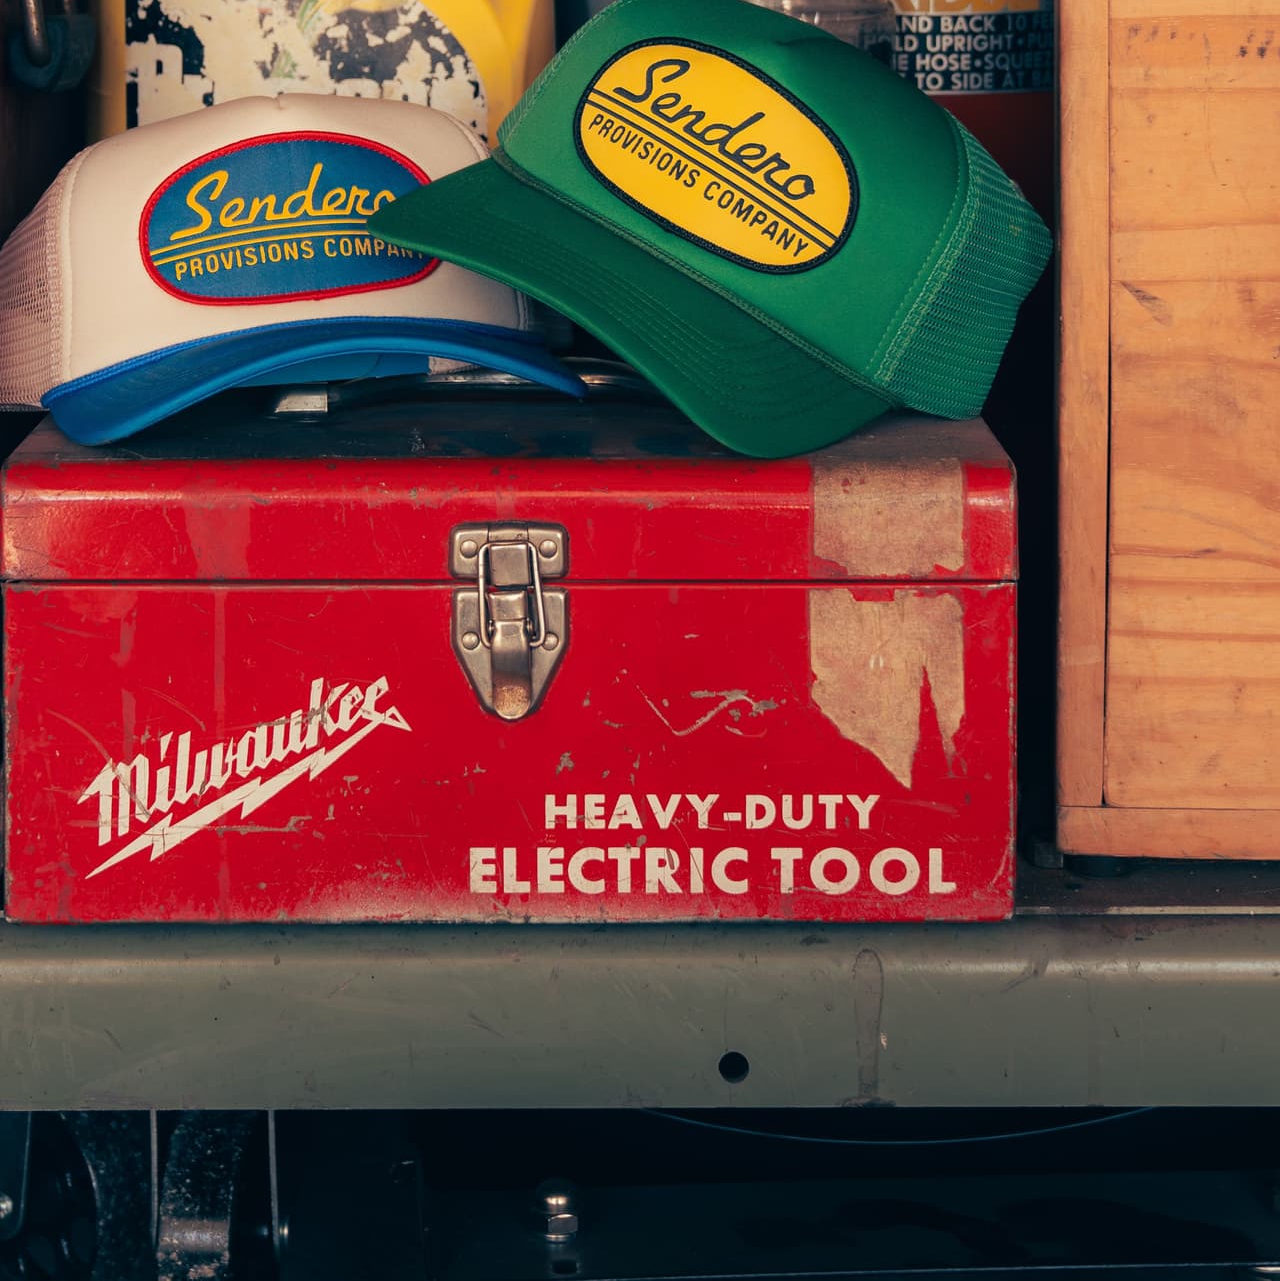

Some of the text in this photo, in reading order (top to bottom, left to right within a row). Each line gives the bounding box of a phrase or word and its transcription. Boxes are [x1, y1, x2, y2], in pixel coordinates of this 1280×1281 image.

[926, 33, 1014, 53] UPRIGHT
[940, 16, 995, 33] BACK
[915, 73, 944, 90] TO
[951, 72, 993, 90] SIDE
[1002, 72, 1024, 88] AT
[916, 54, 971, 71] HOSE
[613, 59, 815, 201] Sendero
[588, 114, 808, 257] PROVISIONS COMPANY
[175, 240, 314, 281] PROVISIONS
[77, 676, 390, 847] Milwaukee
[544, 794, 880, 830] HEAVY-DUTY
[469, 847, 957, 895] ELECTRIC TOOL
